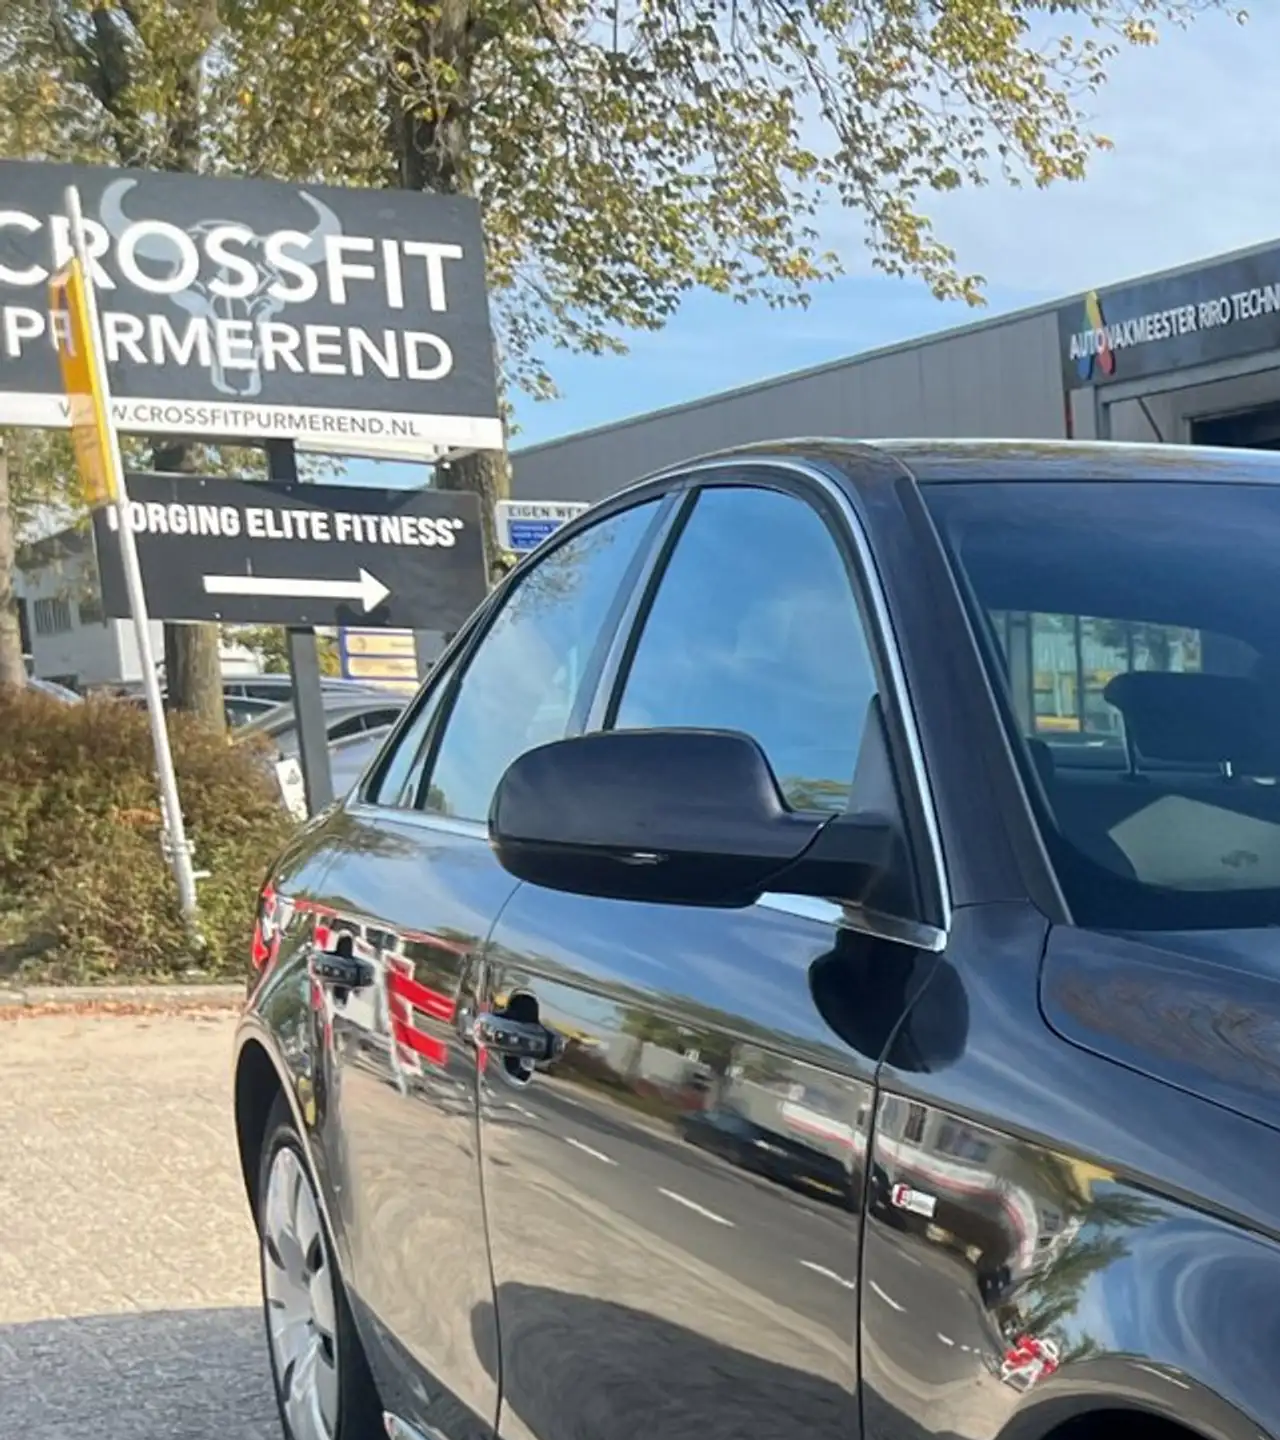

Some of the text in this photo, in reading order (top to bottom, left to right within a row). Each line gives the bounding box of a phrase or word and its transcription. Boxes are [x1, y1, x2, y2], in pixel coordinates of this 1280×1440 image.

[0, 209, 464, 312] CROSSFIT
[3, 305, 454, 381] PRMEREND
[1070, 304, 1197, 360] AUTOVAKMEESTER
[246, 507, 330, 542] ELITE
